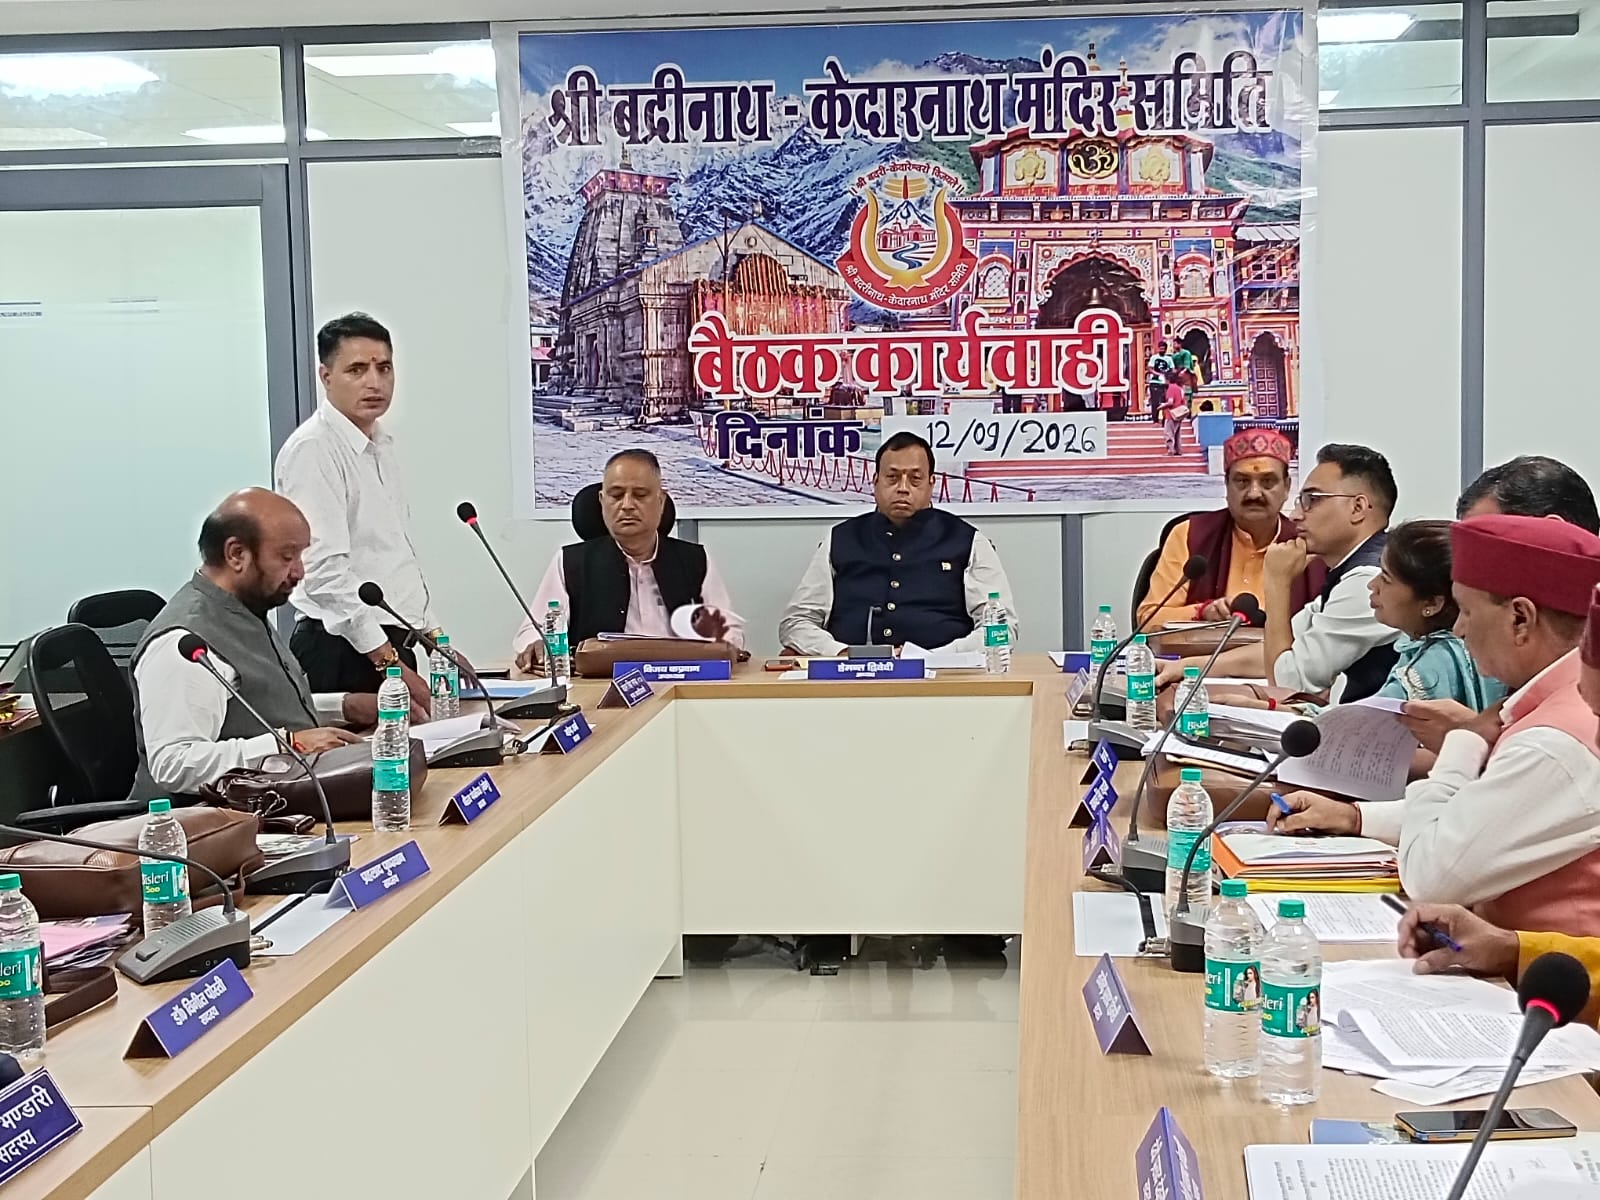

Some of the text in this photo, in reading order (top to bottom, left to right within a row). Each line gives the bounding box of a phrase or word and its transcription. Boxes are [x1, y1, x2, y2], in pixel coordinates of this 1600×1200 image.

[549, 68, 603, 147] श्री
[607, 66, 774, 146] बद्रीनाथ
[804, 59, 1007, 140] केदारनाथ
[1014, 47, 1124, 135] मंदिर
[1128, 51, 1273, 133] समिति
[690, 310, 1130, 396] बैठक कार्यवाही
[714, 407, 866, 460] दिनांक
[926, 418, 1098, 458] 12/09/2026
[0, 1128, 37, 1164] सदस्य
